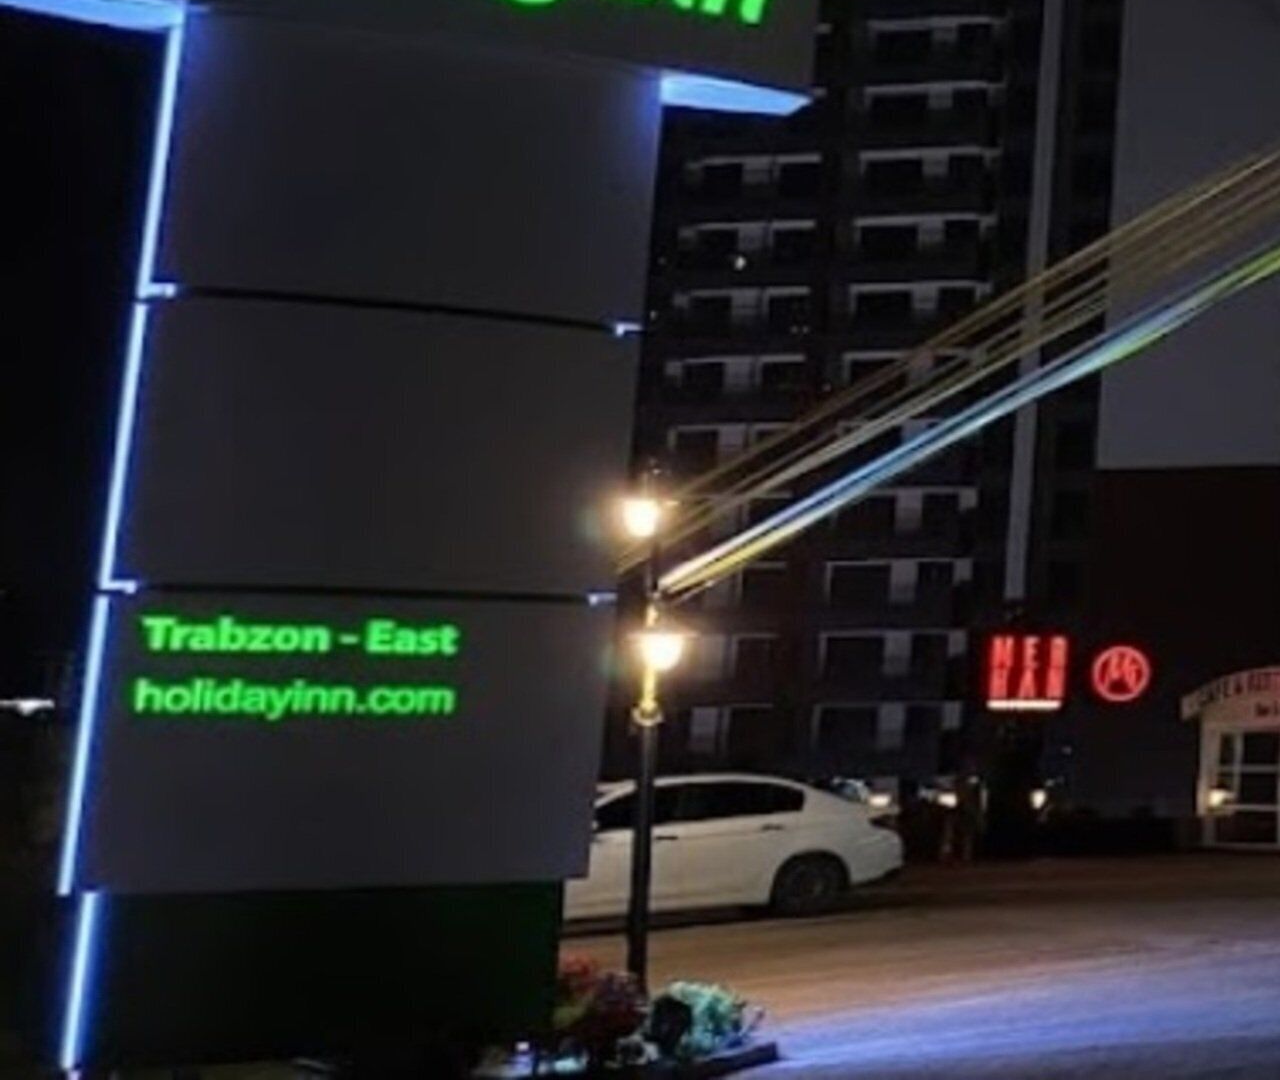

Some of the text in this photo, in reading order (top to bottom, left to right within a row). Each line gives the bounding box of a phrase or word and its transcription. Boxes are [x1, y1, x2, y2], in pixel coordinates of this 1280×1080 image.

[142, 616, 332, 652] Trabzon
[364, 619, 460, 656] East
[134, 677, 457, 720] holidayinn.com
